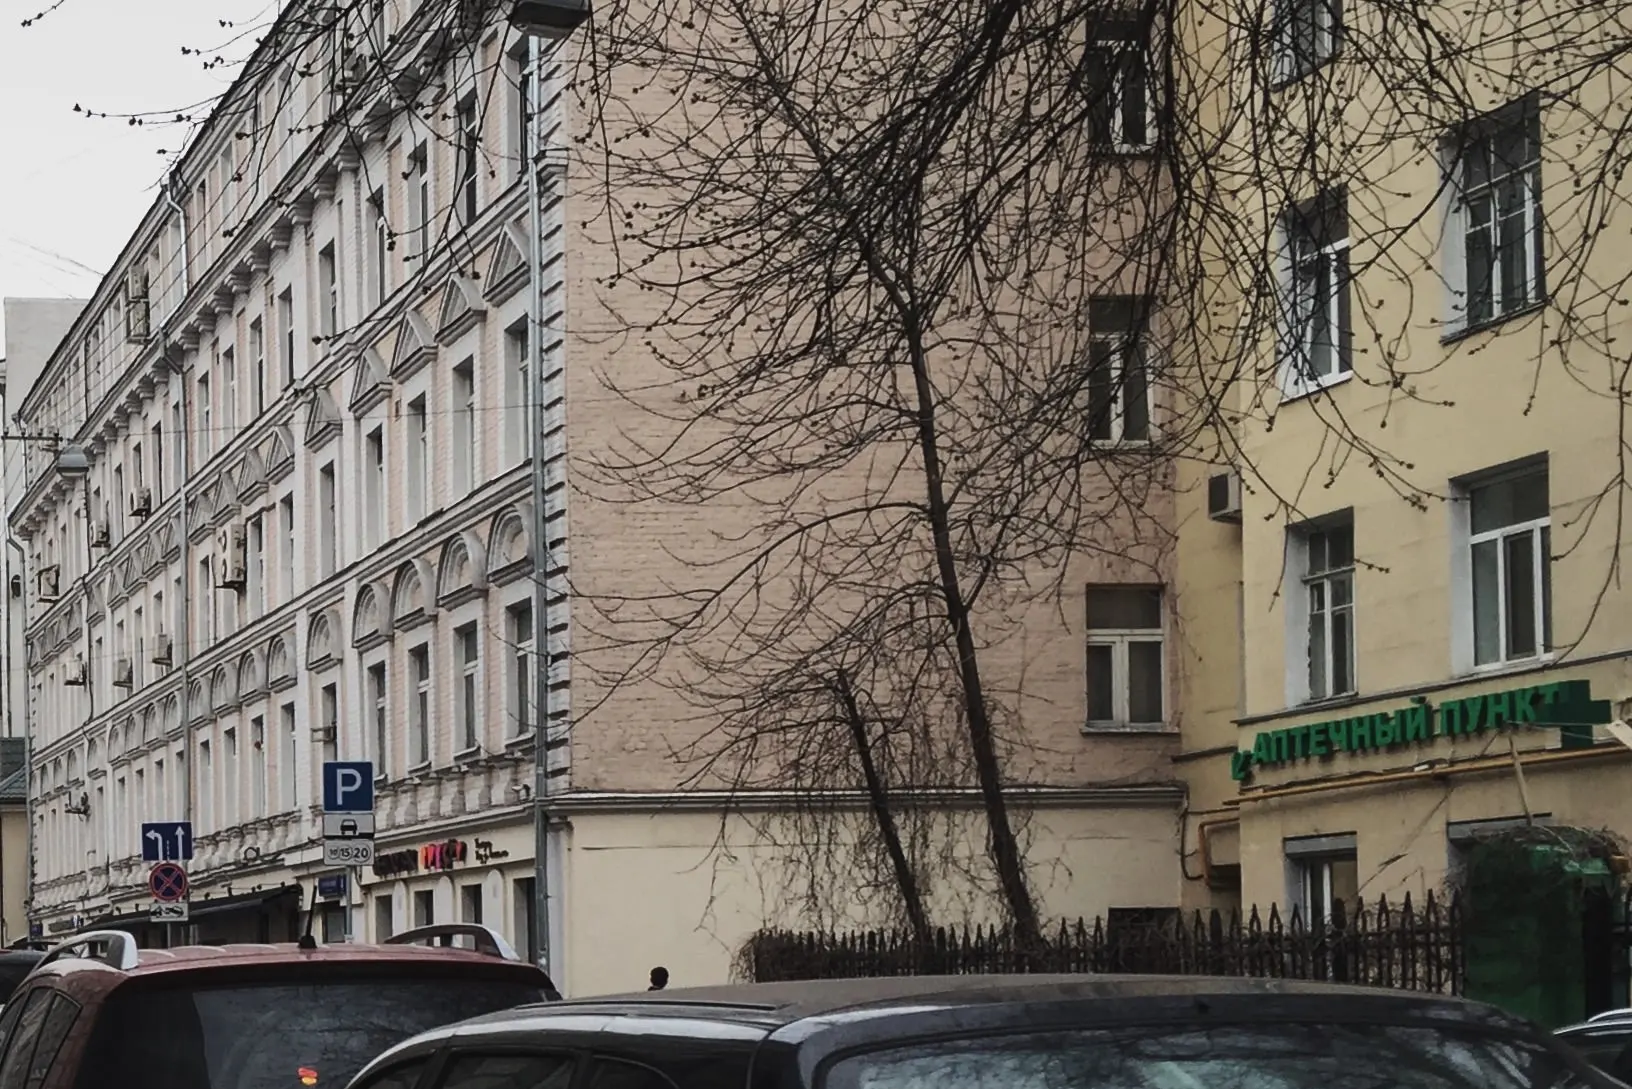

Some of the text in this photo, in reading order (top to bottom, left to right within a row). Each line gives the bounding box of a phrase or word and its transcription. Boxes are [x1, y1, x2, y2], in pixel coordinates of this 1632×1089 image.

[1251, 696, 1430, 766] АПТЕЧНЫЙ
[336, 768, 362, 805] P
[340, 848, 350, 858] 15
[354, 847, 368, 858] 20
